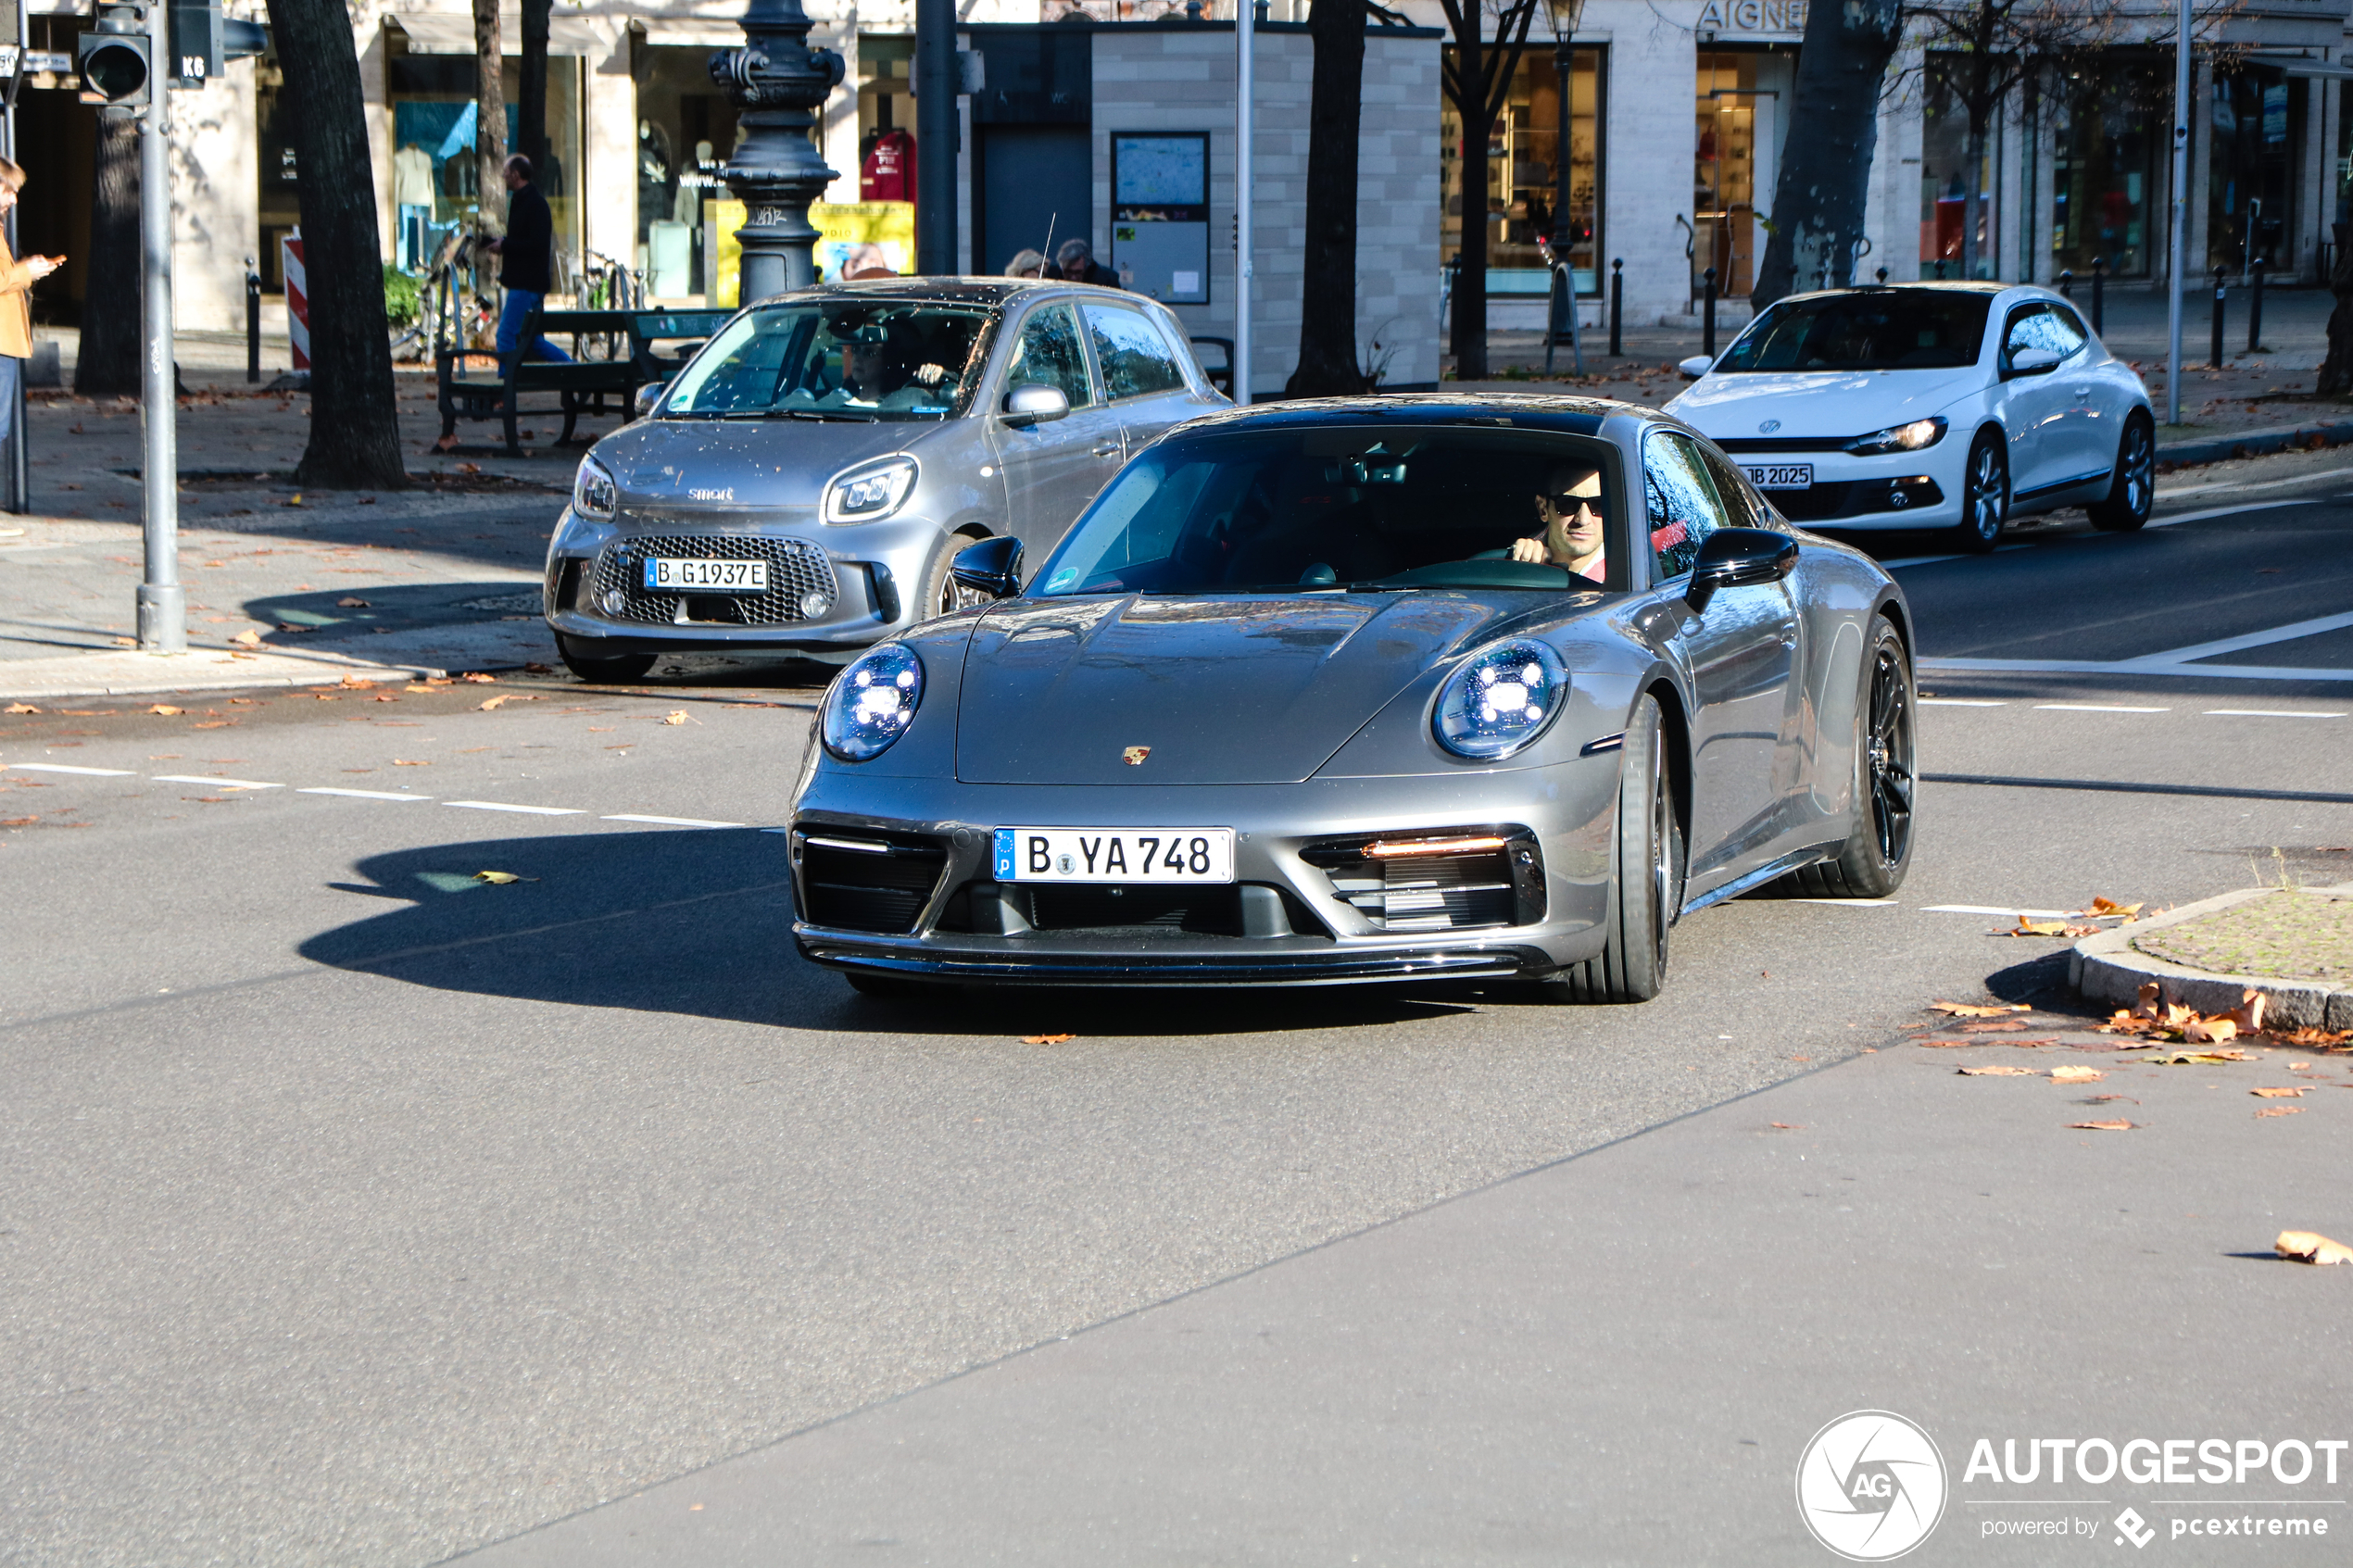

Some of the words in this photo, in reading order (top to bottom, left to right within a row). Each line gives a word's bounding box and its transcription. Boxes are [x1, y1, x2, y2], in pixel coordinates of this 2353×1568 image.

[182, 56, 205, 78] K6
[1051, 92, 1068, 105] WC
[698, 159, 716, 169] see
[718, 159, 726, 170] y
[822, 229, 851, 237] UDIO
[1768, 468, 1809, 484] 2025
[687, 486, 735, 501] smart
[659, 562, 670, 583] B
[1000, 859, 1010, 871] D
[1028, 836, 1051, 872] B
